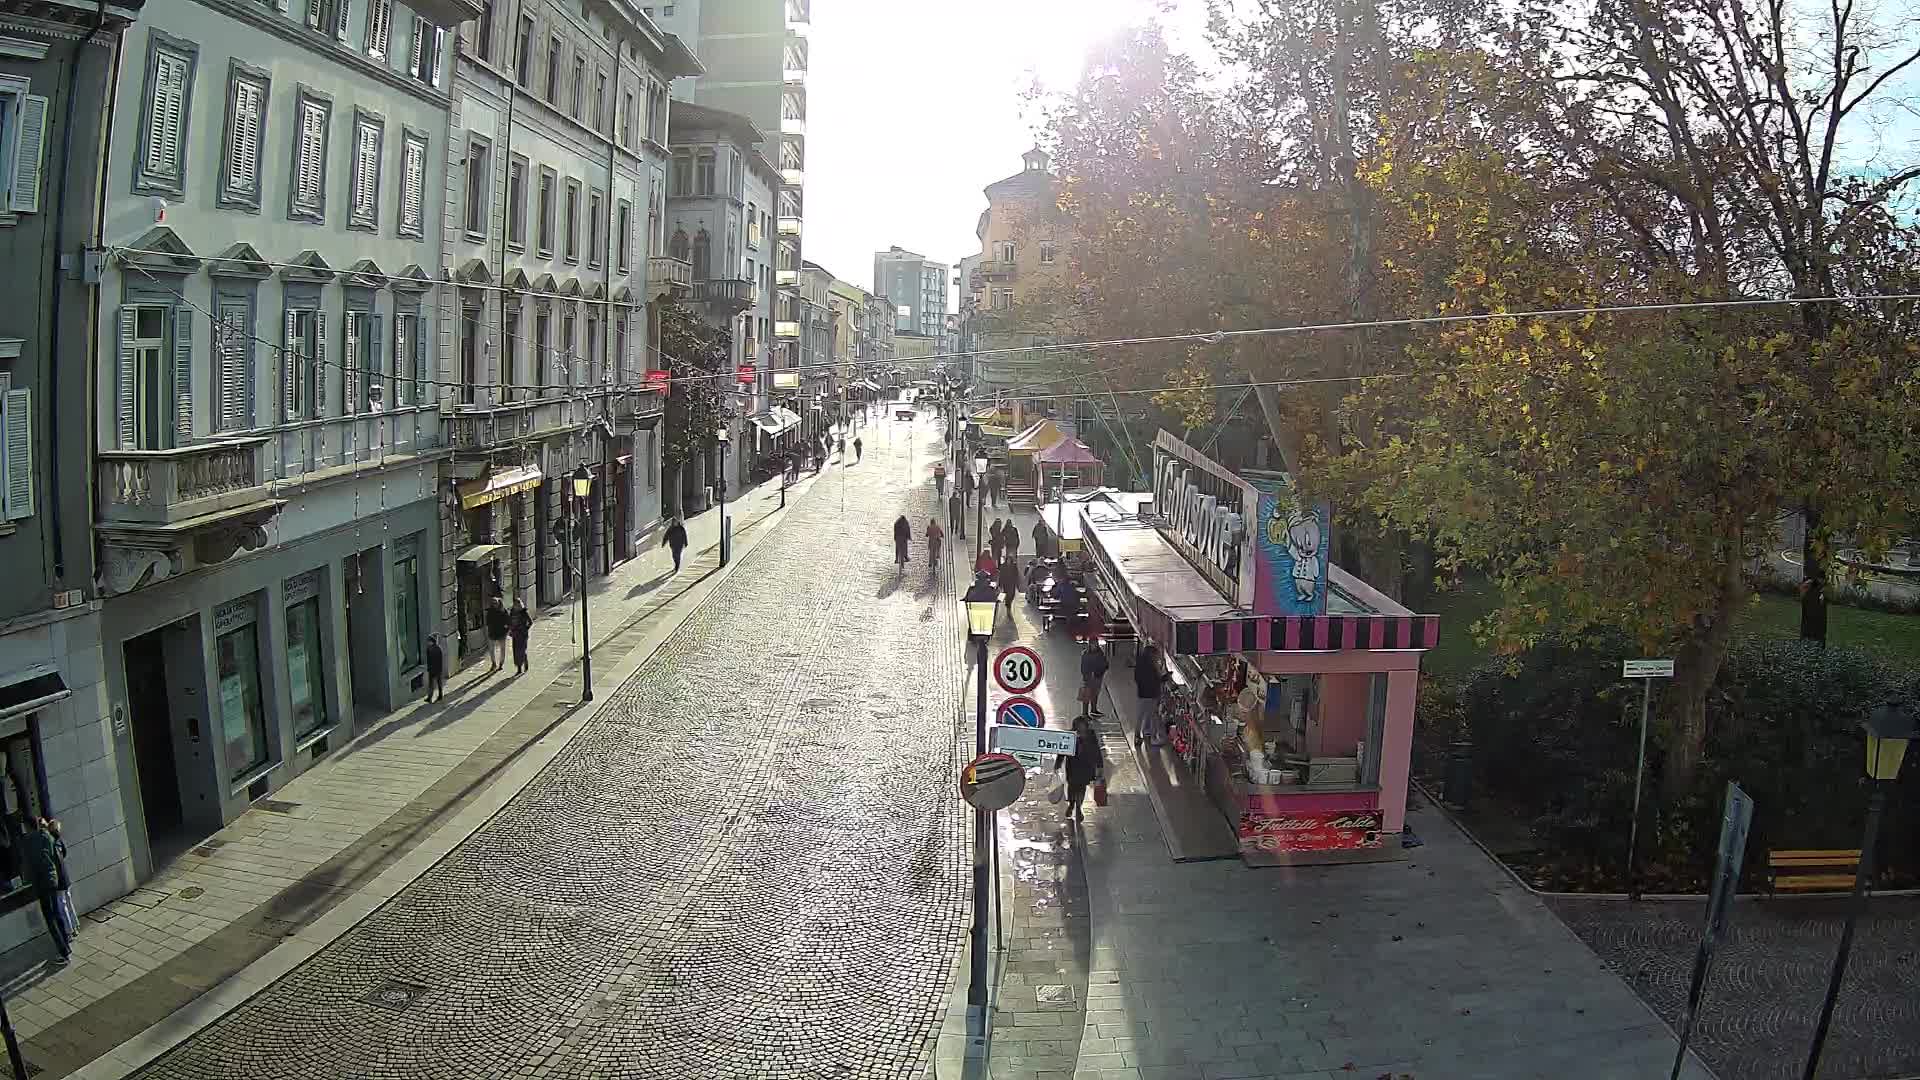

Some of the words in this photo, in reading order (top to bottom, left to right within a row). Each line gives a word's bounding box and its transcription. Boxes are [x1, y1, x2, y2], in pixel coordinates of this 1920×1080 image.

[1005, 659, 1033, 682] 30
[1038, 739, 1069, 750] Dante
[1324, 814, 1377, 826] Calde
